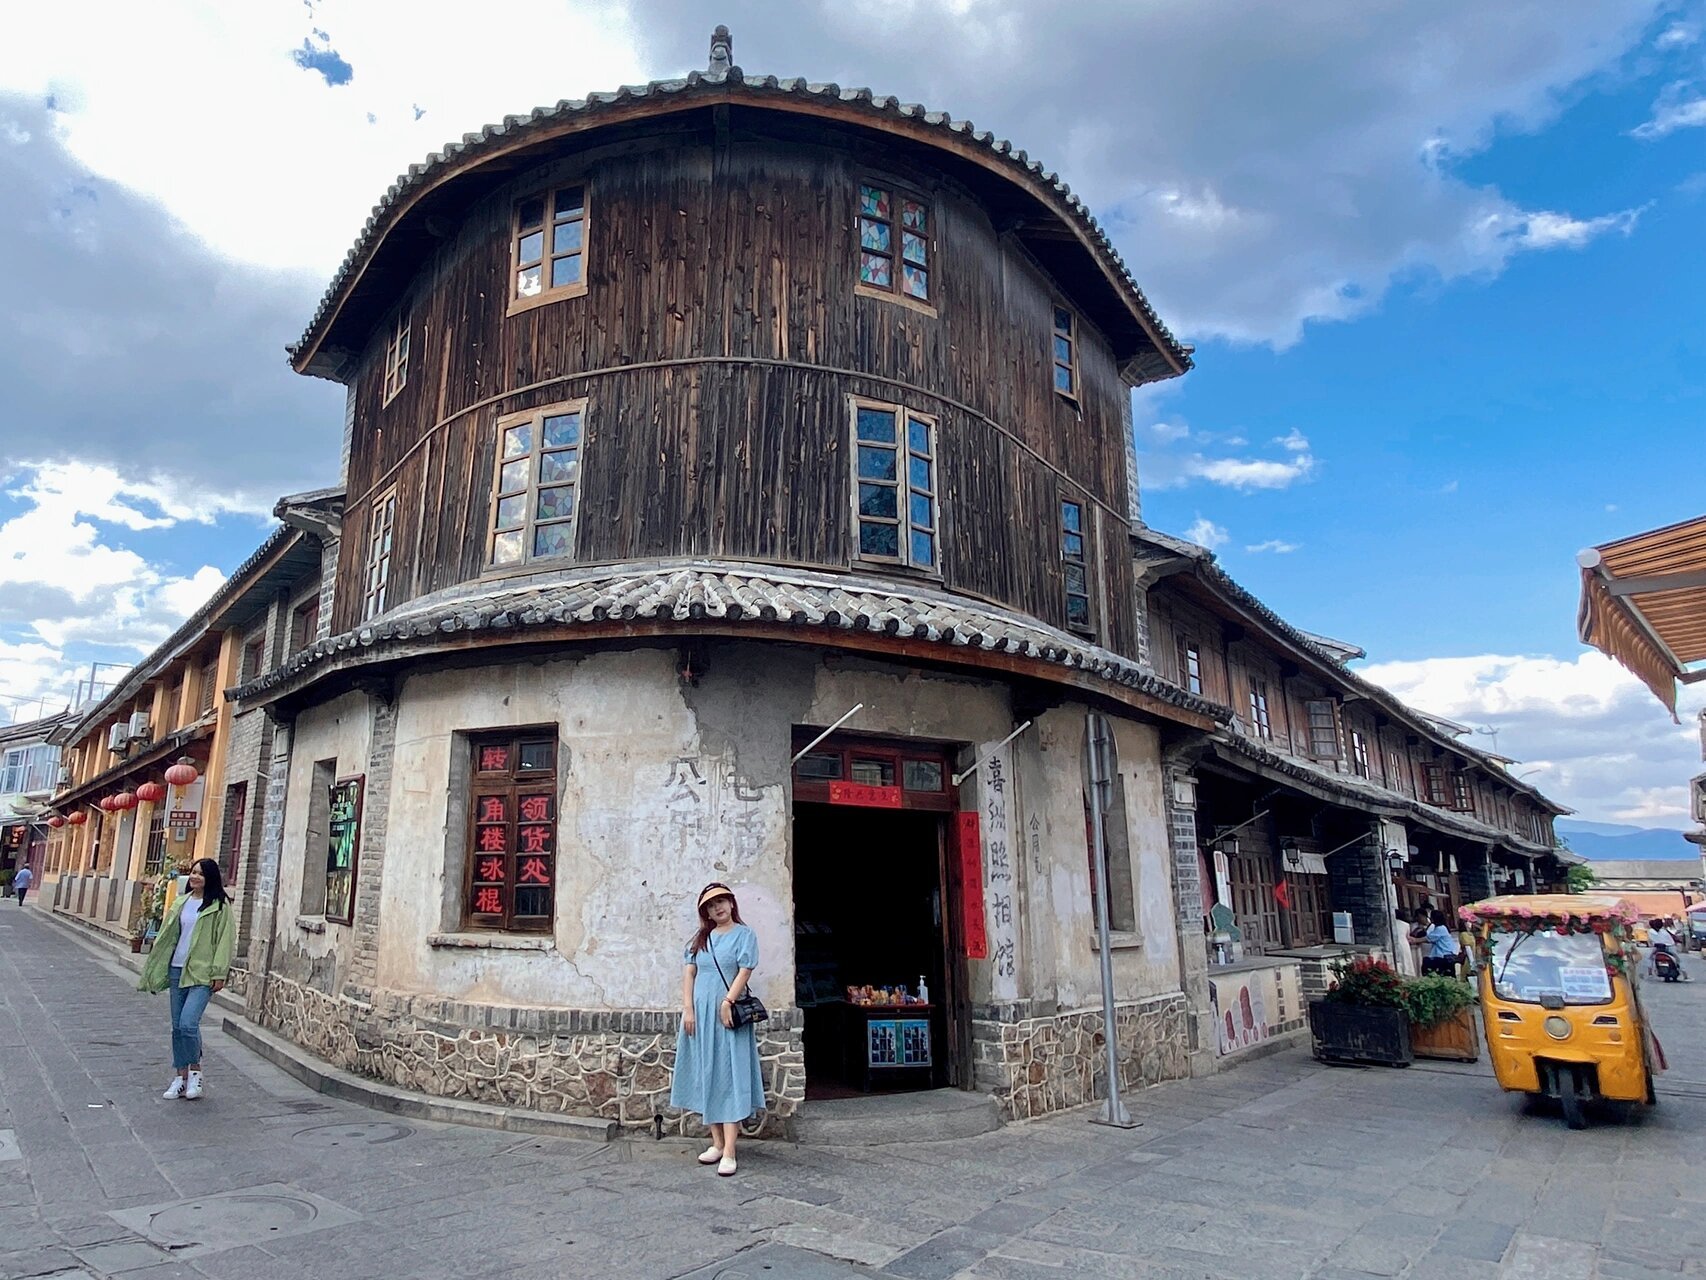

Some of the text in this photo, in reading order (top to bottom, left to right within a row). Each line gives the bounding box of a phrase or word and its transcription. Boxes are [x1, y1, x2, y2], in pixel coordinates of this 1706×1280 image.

[476, 748, 508, 913] 转角楼冰棍
[520, 797, 551, 883] 领货处
